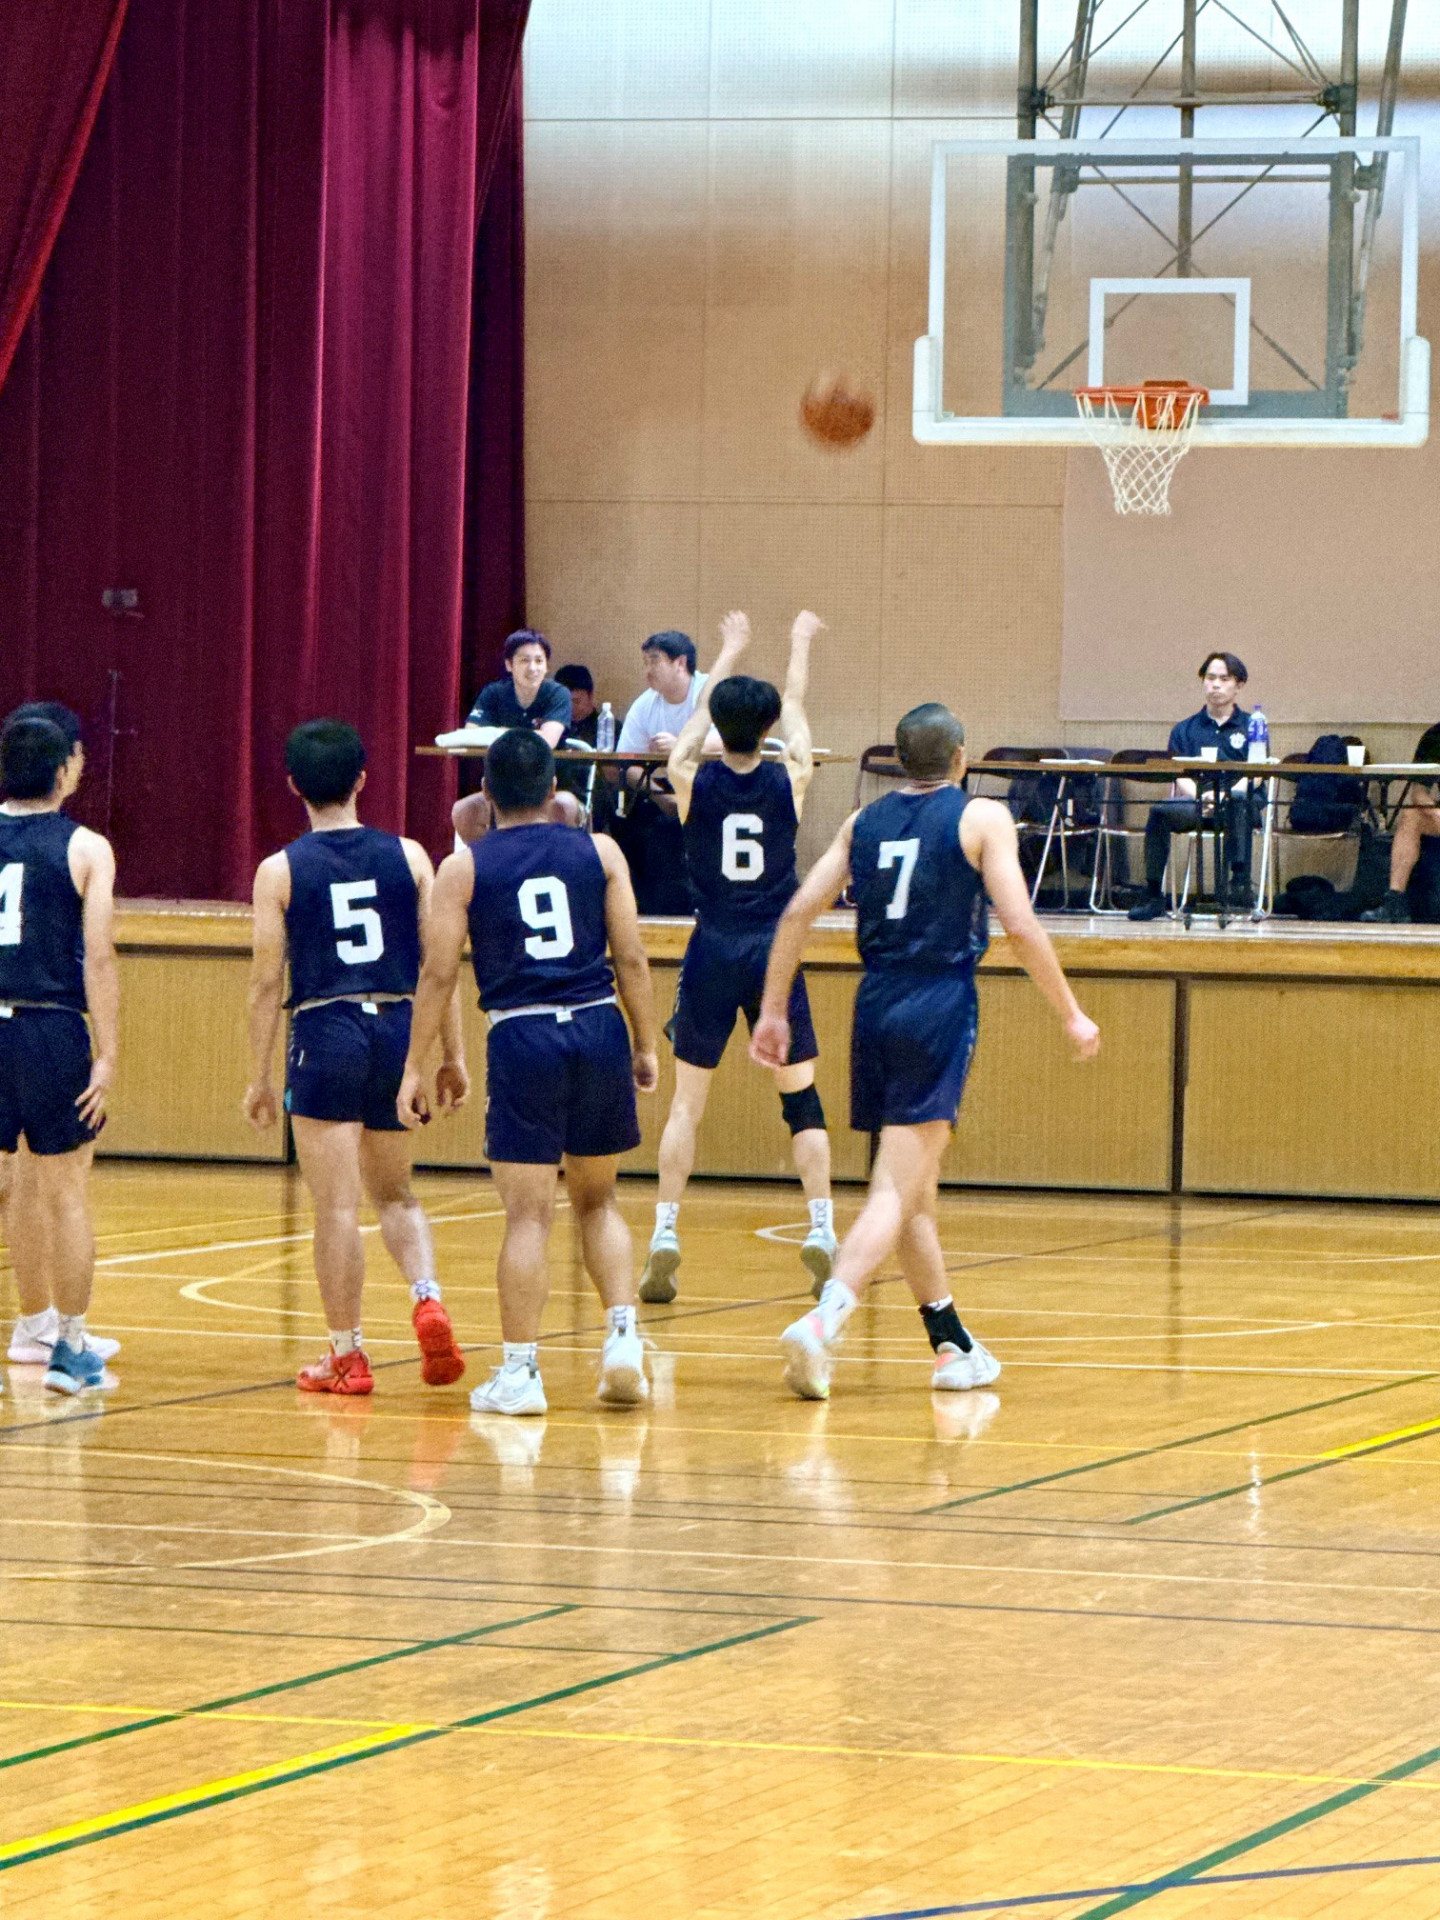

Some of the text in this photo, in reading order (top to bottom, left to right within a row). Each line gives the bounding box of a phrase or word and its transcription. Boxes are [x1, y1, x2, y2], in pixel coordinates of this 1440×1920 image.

[721, 813, 765, 882] 6
[877, 837, 921, 920] 7
[0, 862, 25, 946] 4
[329, 878, 385, 965] 5
[517, 875, 575, 960] 9
